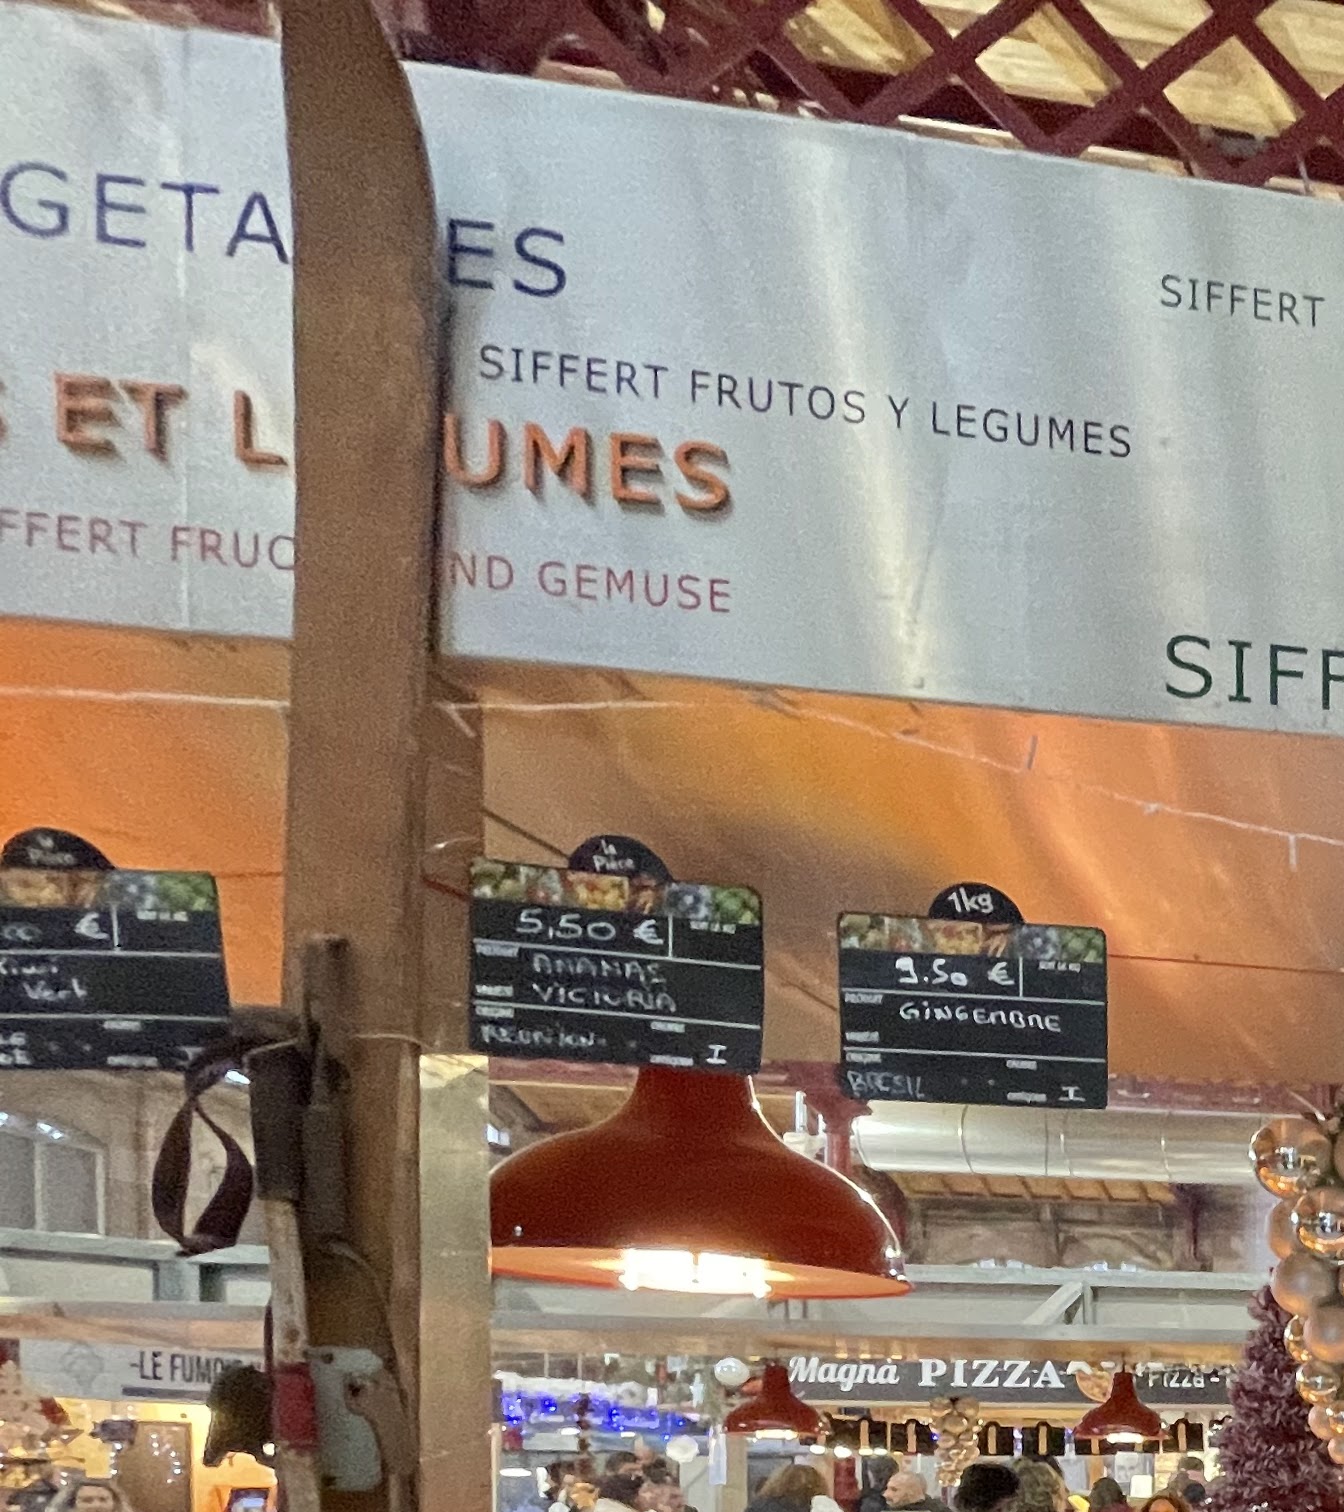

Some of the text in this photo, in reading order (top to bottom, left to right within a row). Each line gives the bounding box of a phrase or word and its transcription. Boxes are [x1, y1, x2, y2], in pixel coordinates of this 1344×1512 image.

[0, 160, 568, 298] GETAES
[1159, 275, 1325, 328] SIFFERT
[479, 345, 1132, 459] SIFFERT FRUTOS Y LEGUMES
[54, 372, 188, 462] ET
[232, 389, 732, 513] LUMES
[448, 551, 514, 592] ND
[538, 559, 731, 613] GEMUSE
[947, 887, 994, 914] 1kg
[74, 911, 111, 941] €
[515, 908, 617, 941] 5,50
[633, 919, 664, 945] €
[986, 961, 1016, 986] €
[789, 1356, 1066, 1392] Magna PIZZA
